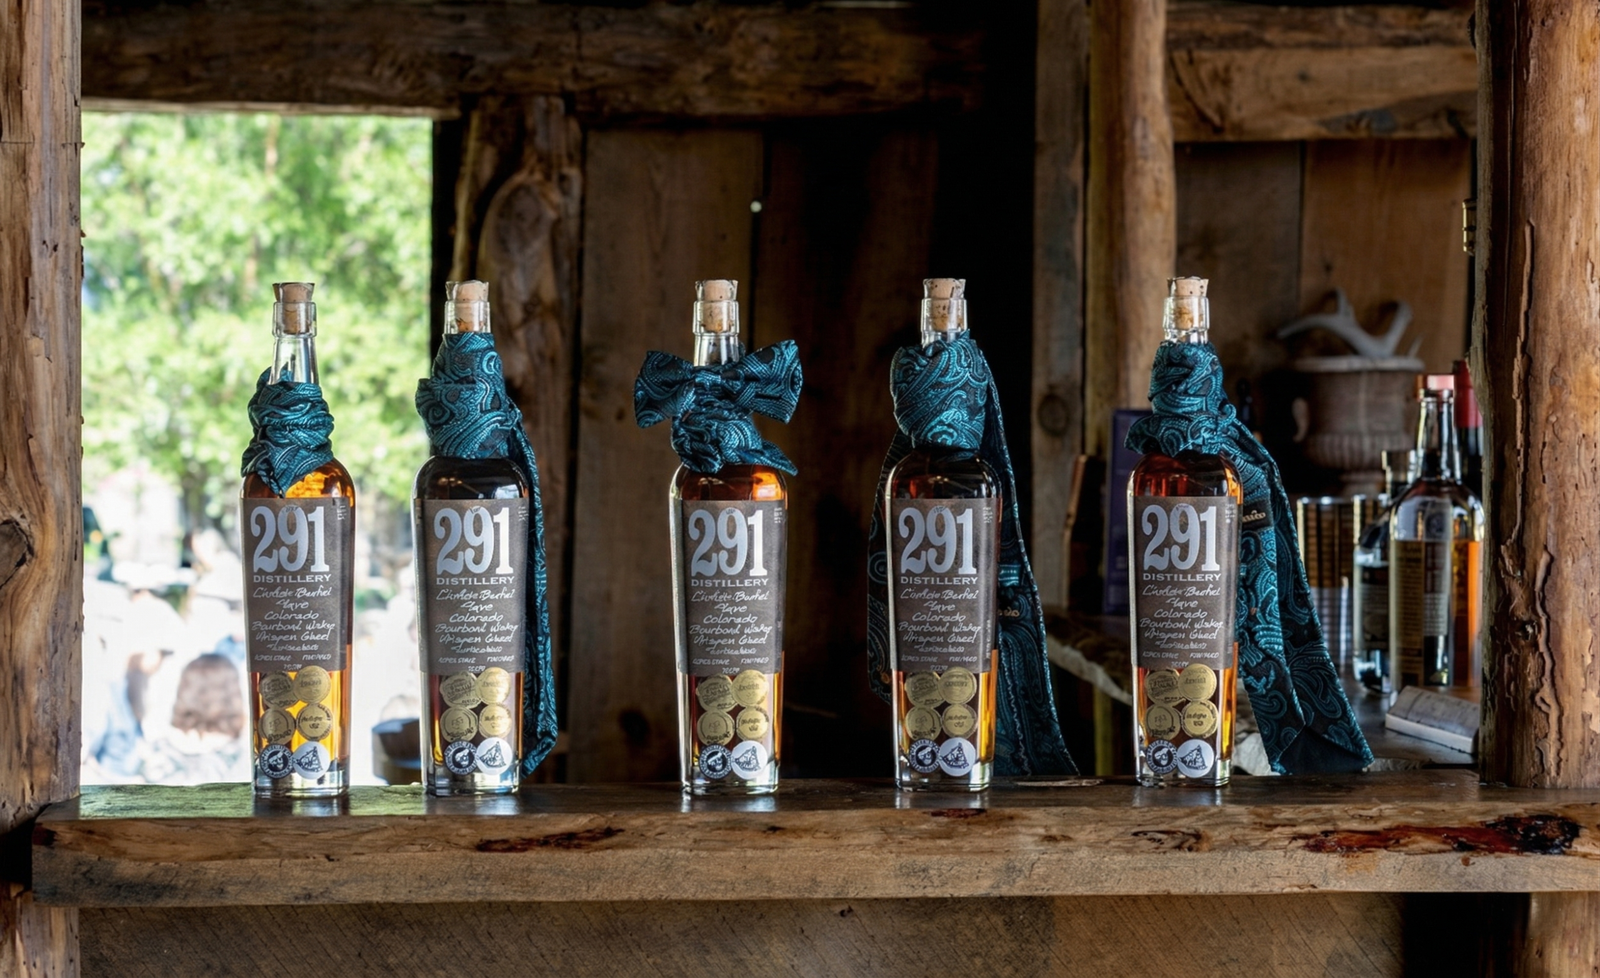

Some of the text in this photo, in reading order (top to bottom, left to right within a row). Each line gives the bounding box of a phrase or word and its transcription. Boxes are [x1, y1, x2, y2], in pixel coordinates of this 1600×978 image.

[251, 505, 330, 572] 291
[434, 505, 513, 575] 291
[688, 507, 767, 576] 291
[898, 505, 976, 575] 291
[1142, 503, 1220, 571] 291
[253, 574, 331, 583] DISTILLERY
[437, 576, 515, 585] DISTILLERY
[691, 578, 769, 587] DISTILLERY
[901, 577, 978, 585] DISTILLERY
